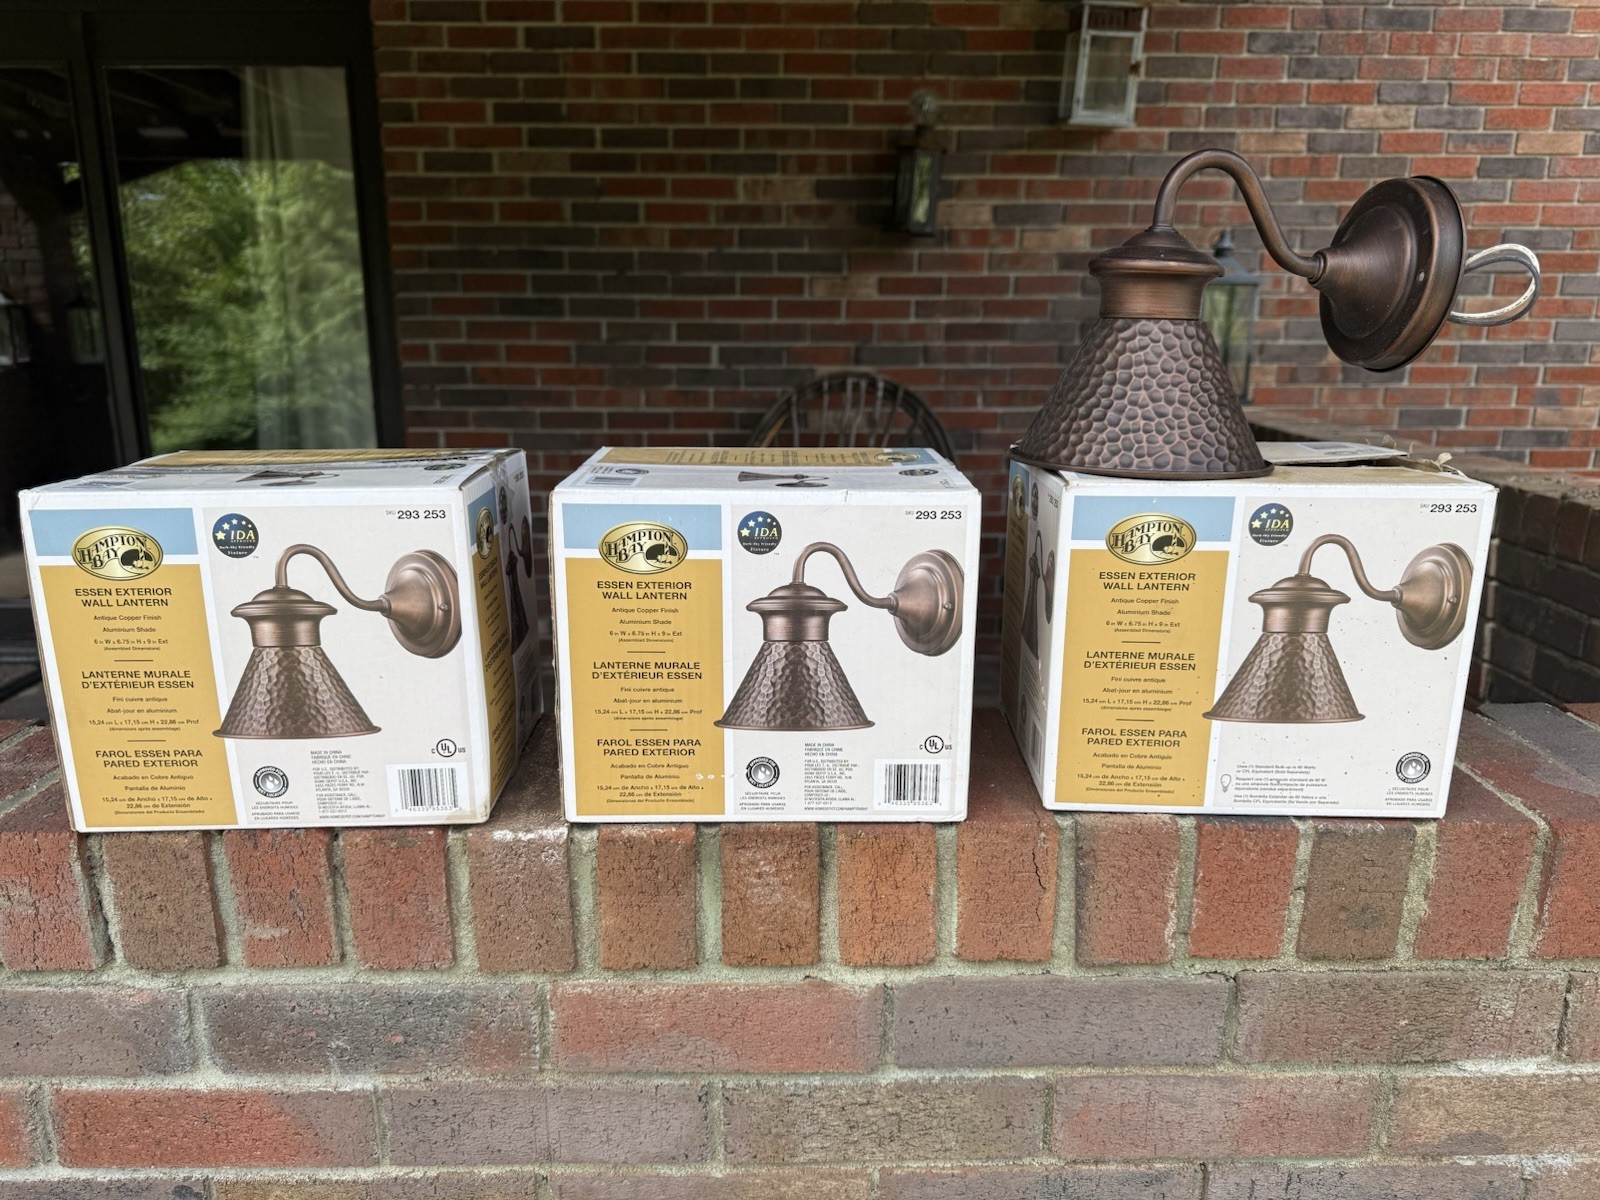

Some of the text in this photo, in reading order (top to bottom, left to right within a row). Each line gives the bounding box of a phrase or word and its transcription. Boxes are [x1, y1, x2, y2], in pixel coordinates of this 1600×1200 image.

[1430, 504, 1477, 512] 293 253
[398, 510, 446, 519] 293 253
[916, 510, 962, 520] 293 253
[1266, 519, 1289, 528] IDA
[231, 530, 255, 540] IDA
[754, 528, 778, 536] IDA
[1112, 522, 1182, 548] HAMPTON
[605, 530, 672, 558] HAMPTON
[1123, 533, 1154, 554] BAY
[78, 536, 147, 563] HAMPTON
[617, 542, 646, 562] BAY
[92, 547, 120, 568] BAY
[1139, 572, 1196, 581] EXTERIOR
[597, 581, 633, 589] ESSEN
[1137, 583, 1190, 591] LANTERN
[75, 588, 172, 596] ESSEN EXTERIOR
[81, 599, 113, 607] WALL
[1087, 651, 1195, 661] LANTERNE MURALE
[1084, 660, 1196, 671] D'EXTÉRIEUR ESSEN
[82, 671, 141, 679] LANTERNE
[592, 670, 664, 679] D'EXTÉRIEUR
[82, 680, 155, 689] D'EXTÉRIEUR
[1082, 728, 1117, 736] FAROL
[1120, 729, 1155, 737] ESSEN
[1126, 739, 1180, 747] EXTERIOR
